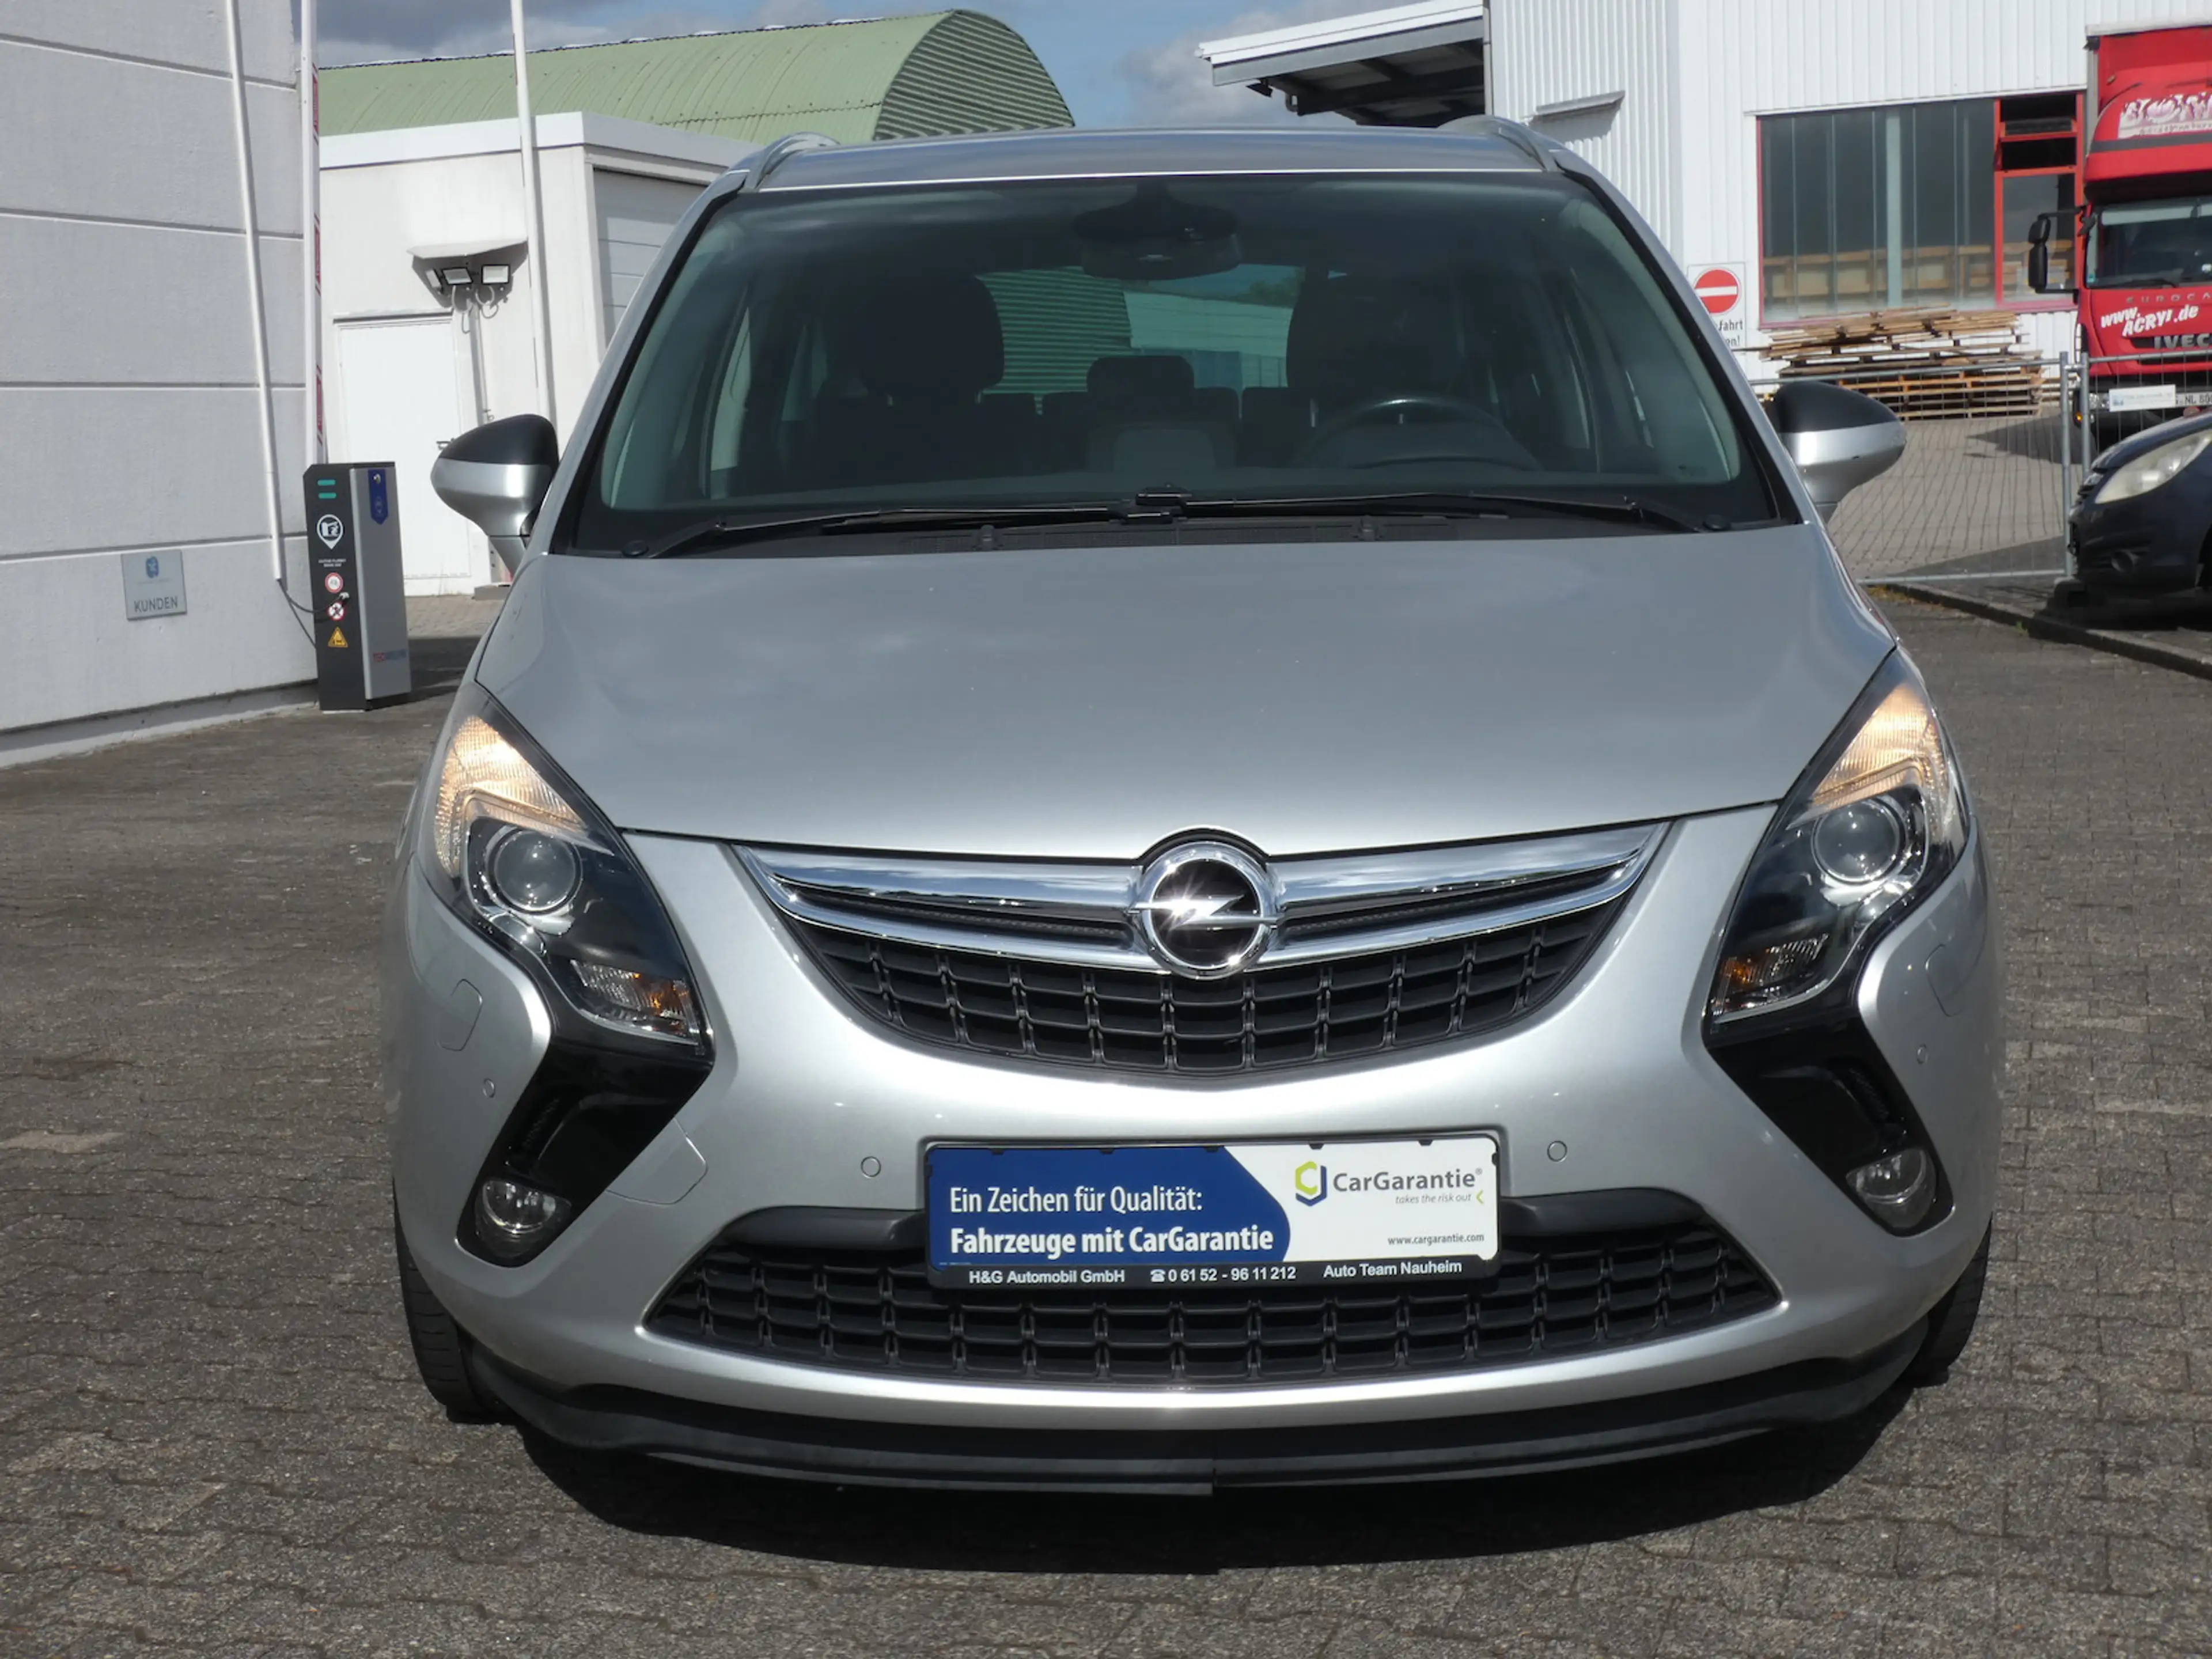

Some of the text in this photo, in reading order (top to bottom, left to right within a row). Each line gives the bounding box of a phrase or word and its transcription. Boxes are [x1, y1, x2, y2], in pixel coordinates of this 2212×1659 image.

[134, 596, 178, 613] KUNDEN
[950, 1185, 1202, 1214] Ein Zeichen für Qualität:
[1395, 1192, 1472, 1204] takes the risk out
[951, 1224, 1274, 1260] Fahrzeuge mit CarGarantie
[1388, 1233, 1484, 1246] www.cargarantie.com
[969, 1269, 1125, 1284] H&G Automobil GmbH
[1180, 1268, 1196, 1282] 61
[1200, 1268, 1217, 1281] 52
[1230, 1268, 1249, 1281] 96
[1252, 1267, 1267, 1280] 11
[1270, 1267, 1296, 1280] 212
[1324, 1260, 1462, 1278] Auto Team Nauheim
